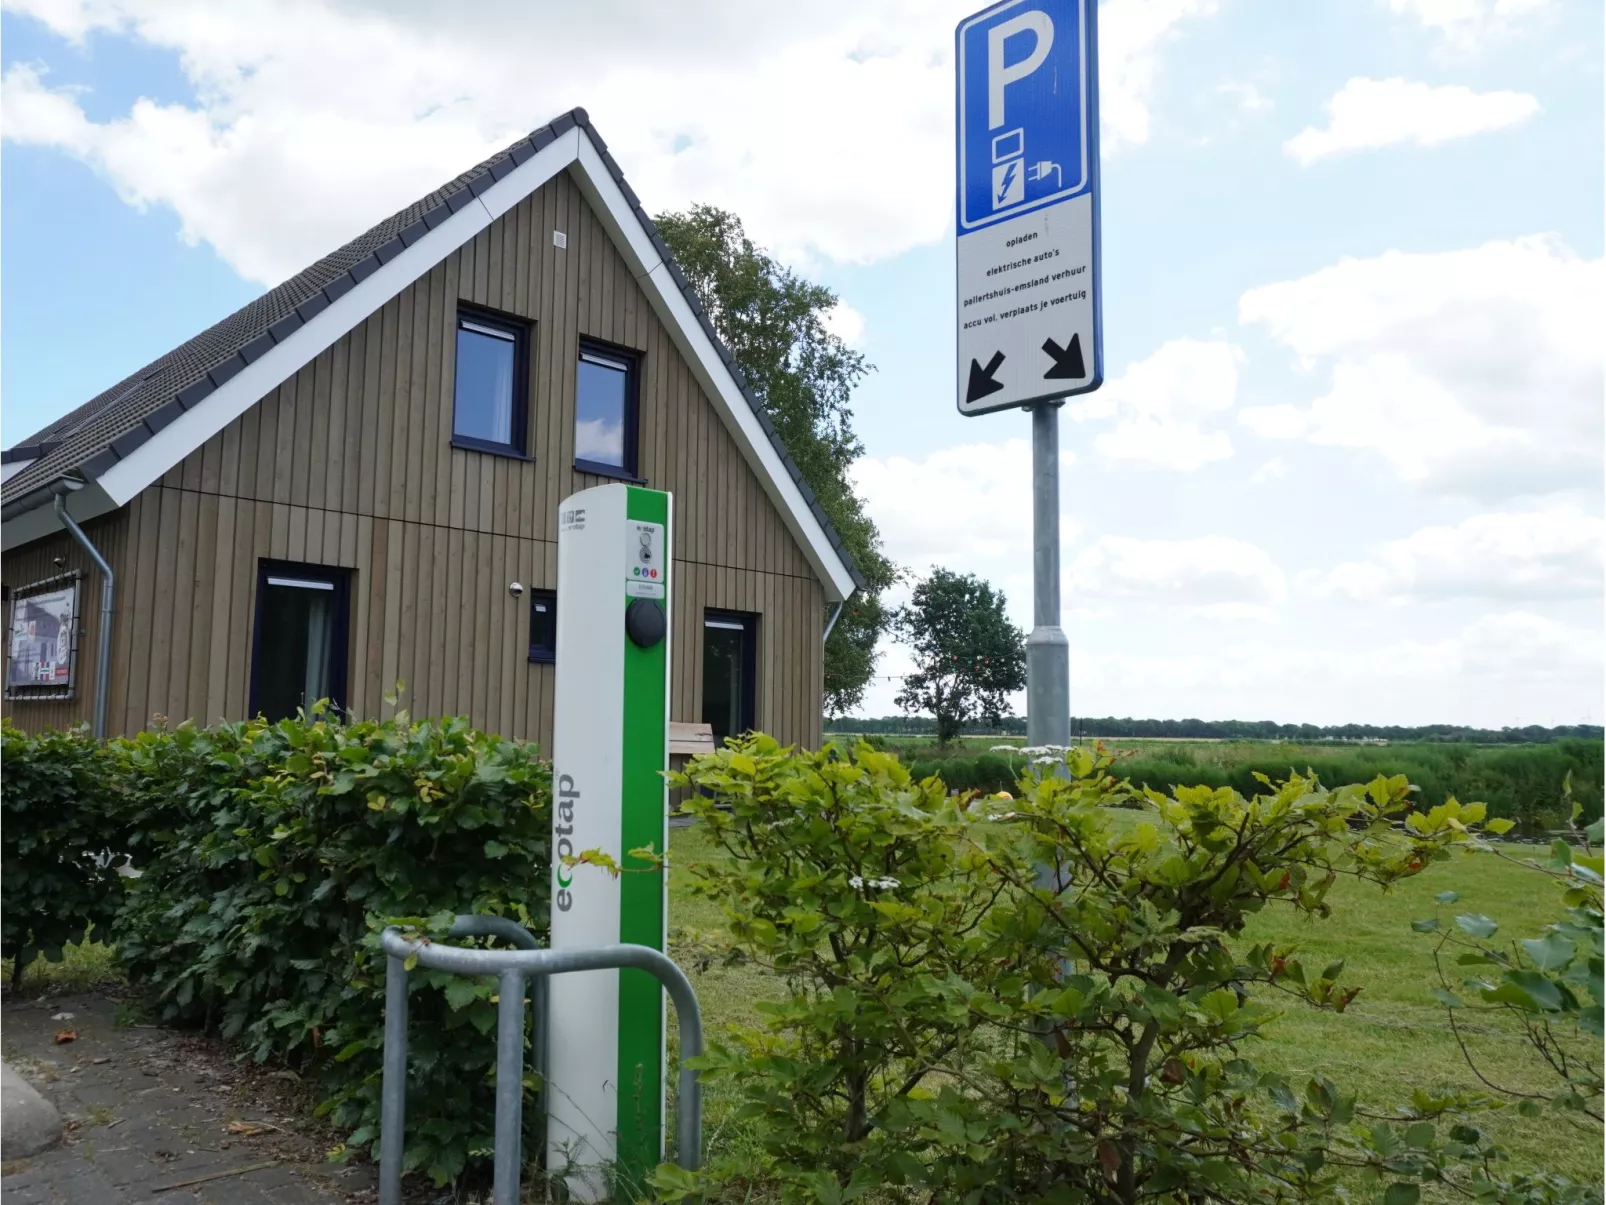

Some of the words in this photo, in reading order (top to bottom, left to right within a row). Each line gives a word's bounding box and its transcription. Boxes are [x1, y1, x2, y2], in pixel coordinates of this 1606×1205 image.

[988, 10, 1054, 131] P
[1006, 232, 1038, 247] opladen
[986, 257, 1032, 277] elektrische
[1033, 249, 1060, 263] auto's
[1051, 265, 1087, 282] verhuur
[963, 319, 982, 330] accu
[999, 303, 1039, 319] verplaats
[1040, 300, 1048, 311] je
[1050, 289, 1087, 306] voertuig
